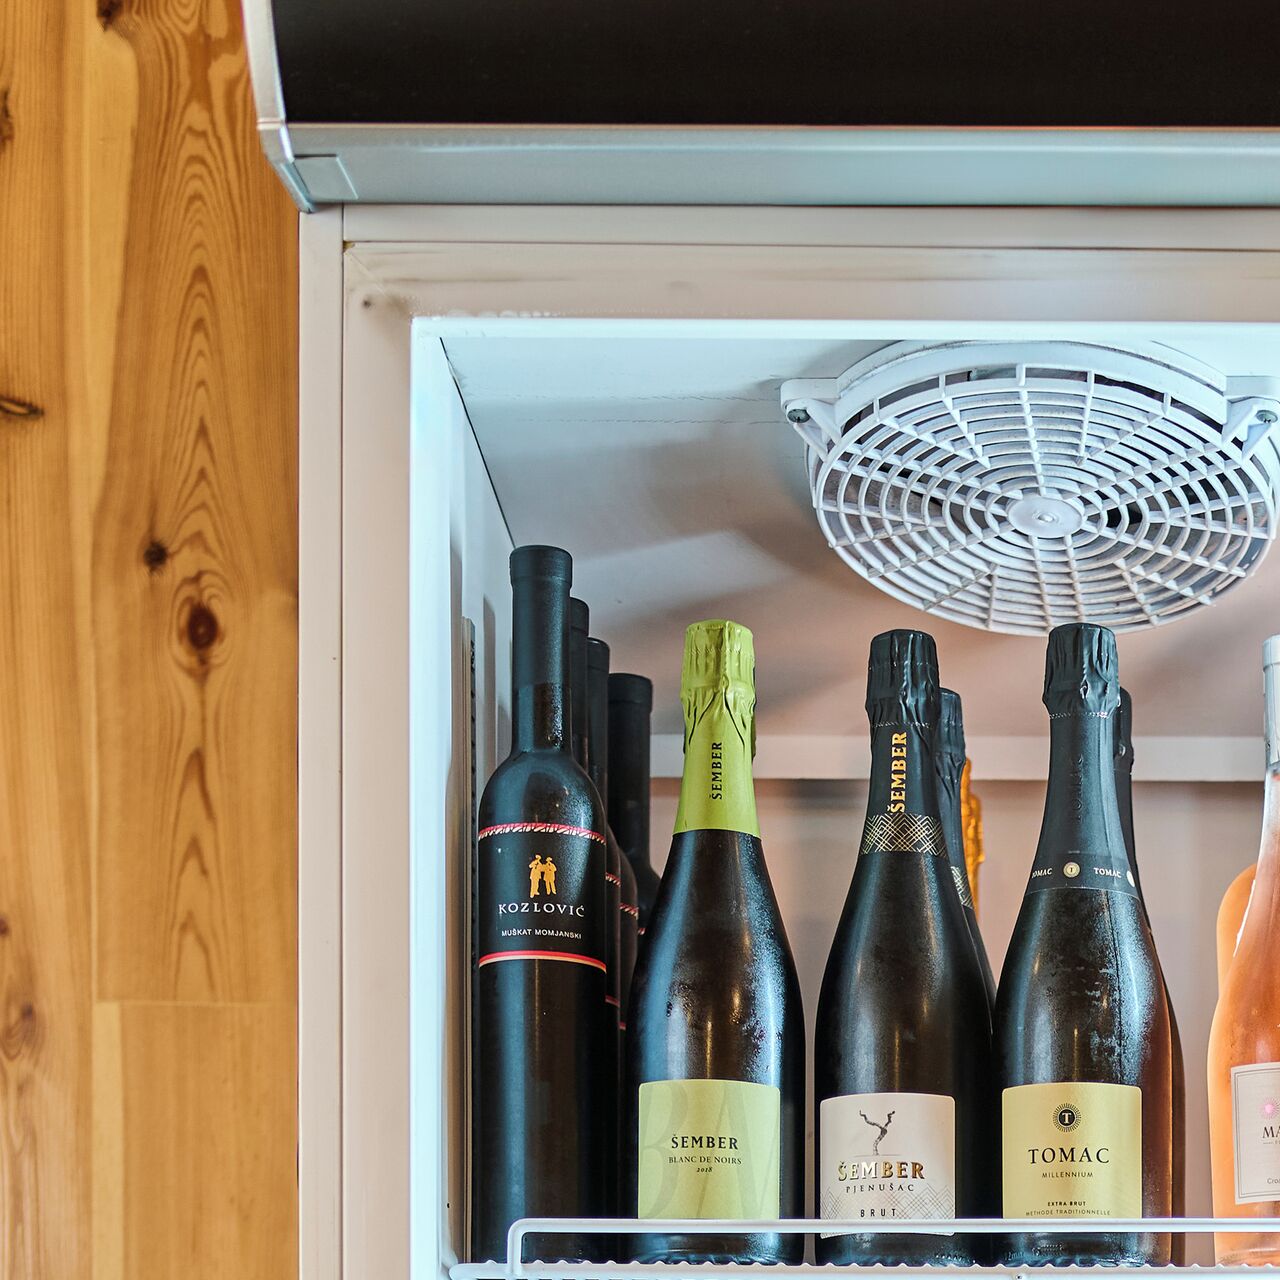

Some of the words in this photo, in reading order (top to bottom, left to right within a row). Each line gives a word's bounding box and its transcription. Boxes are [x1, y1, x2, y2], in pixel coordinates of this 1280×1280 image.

[708, 742, 723, 800] ŠEMBER
[887, 731, 907, 813] ŠEMBER
[1093, 867, 1122, 878] TOMAC
[498, 902, 585, 917] KOZLOVIĆ
[501, 928, 532, 937] MUŠKAT
[534, 928, 582, 939] MOMJANSKI
[671, 1134, 738, 1150] ŠEMBER
[668, 1156, 697, 1164] BLANC
[714, 1156, 742, 1165] NOIRS
[1027, 1147, 1110, 1164] TOMAC
[838, 1160, 925, 1182] ŠEMBER
[846, 1183, 915, 1194] PJENUŠAC
[860, 1208, 896, 1218] BRUT
